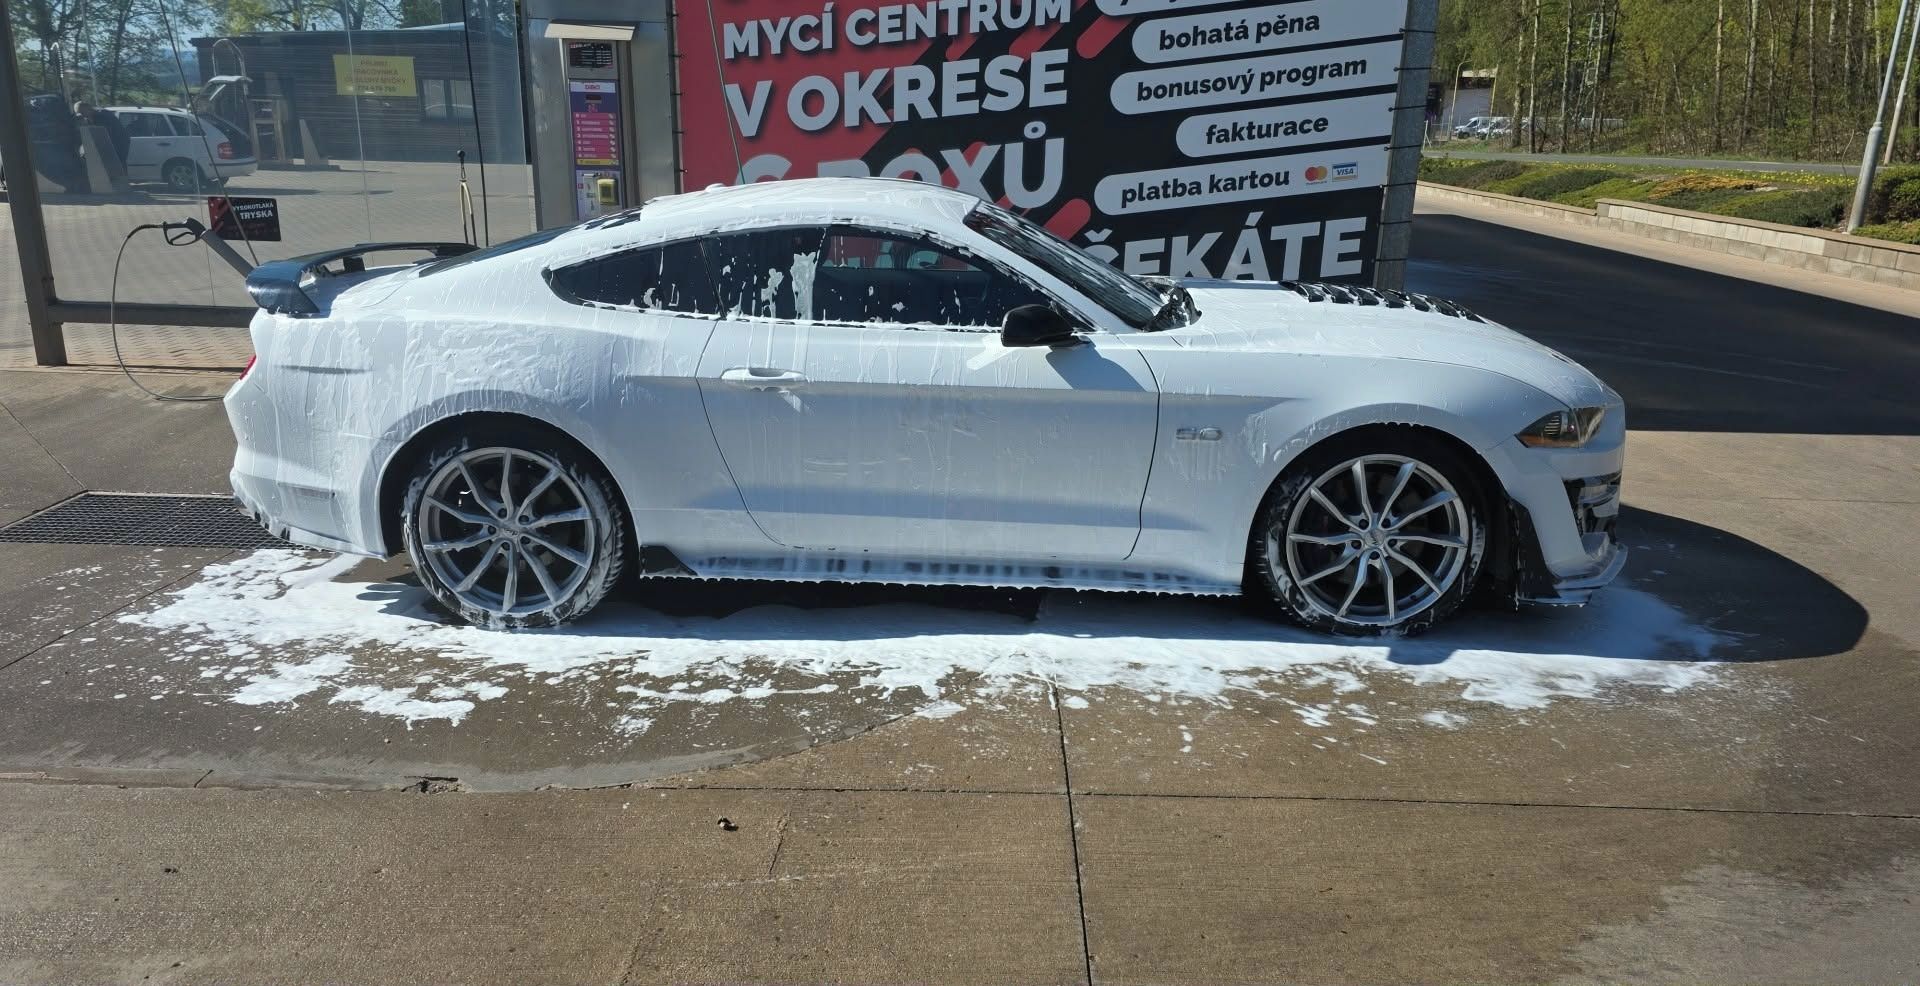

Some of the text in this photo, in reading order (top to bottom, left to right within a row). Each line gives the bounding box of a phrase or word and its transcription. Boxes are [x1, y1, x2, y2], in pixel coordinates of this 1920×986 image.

[723, 0, 1071, 60] MYCÍ CENTRUM
[1159, 14, 1320, 51] bohatá pěna
[725, 48, 1070, 138] V OKRESE
[1137, 58, 1367, 102] bonusový program
[1205, 116, 1329, 145] fakturace
[818, 121, 1064, 209] XŮ
[1336, 167, 1354, 176] VISA
[1121, 170, 1290, 208] platba kartou
[239, 210, 274, 220] TRYSKA
